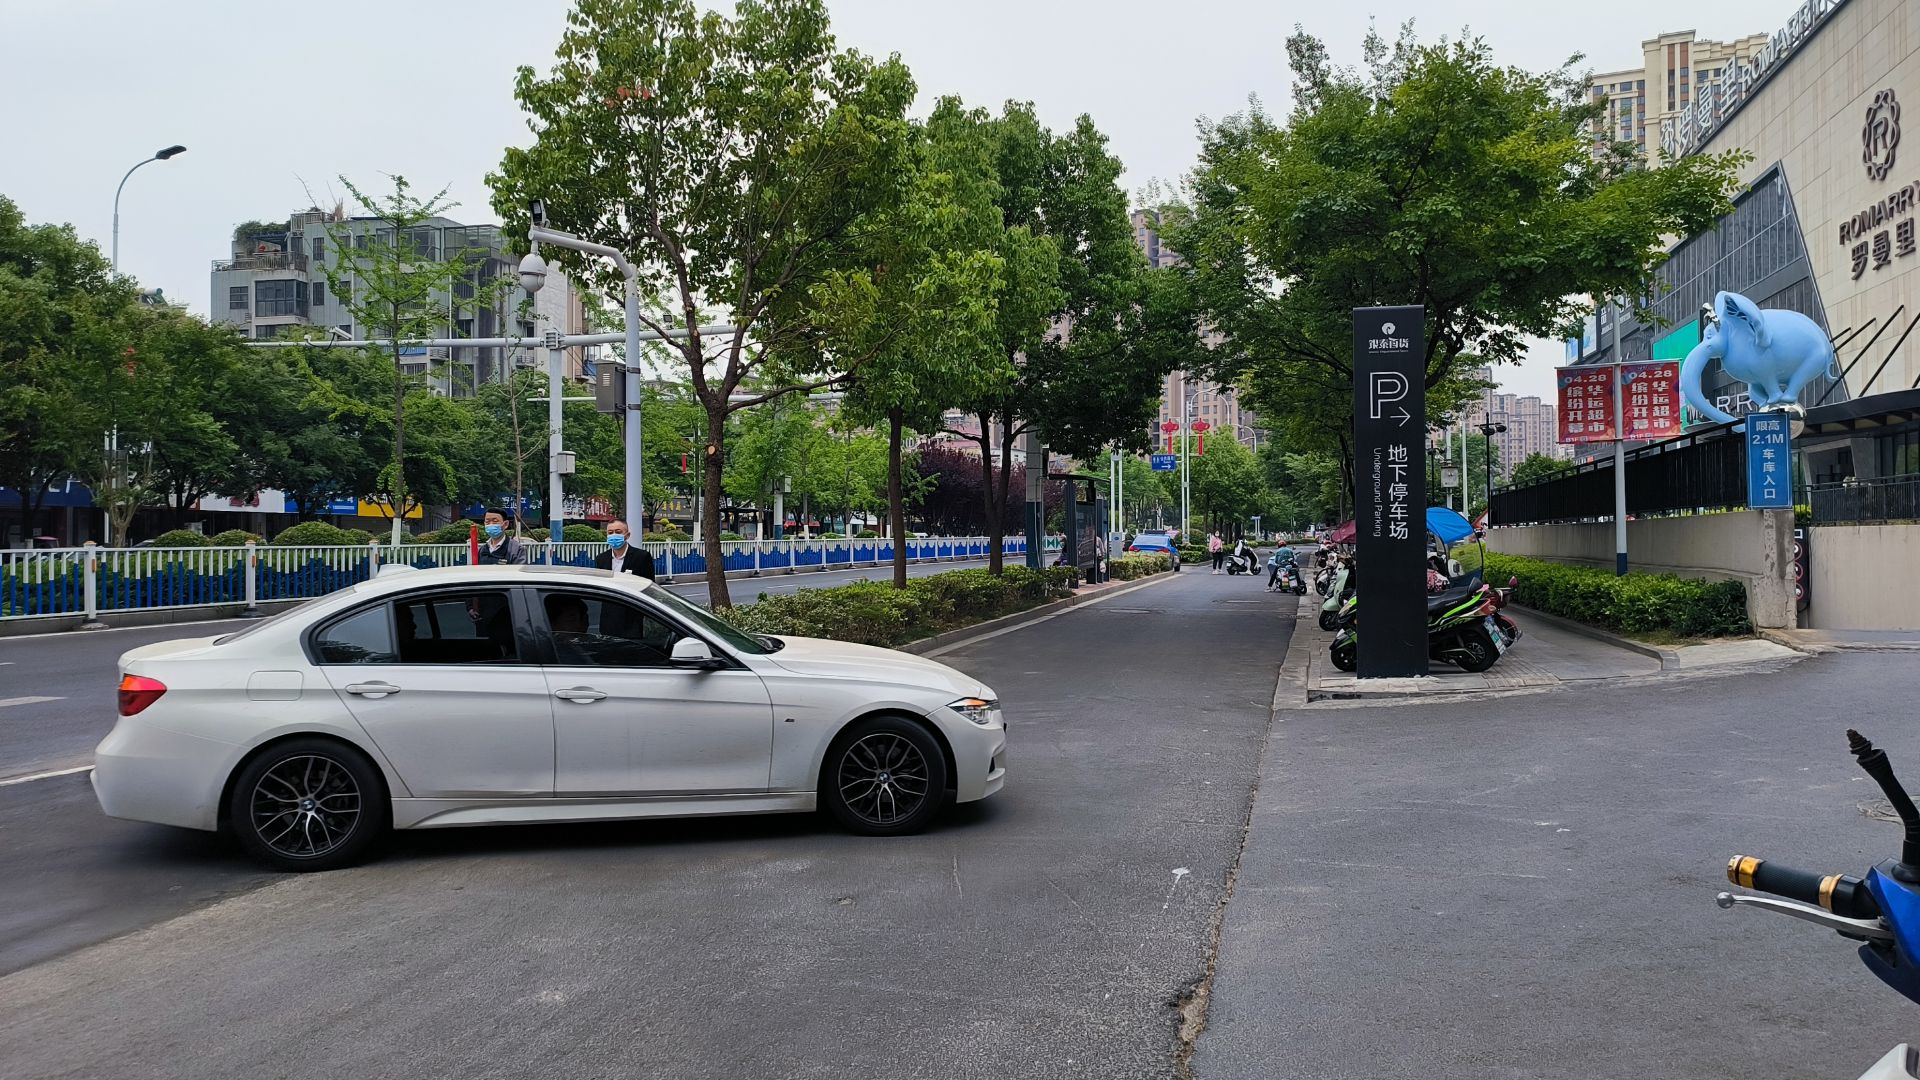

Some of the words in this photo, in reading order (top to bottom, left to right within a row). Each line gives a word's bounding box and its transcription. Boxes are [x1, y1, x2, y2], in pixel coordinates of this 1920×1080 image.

[1851, 217, 1916, 280] 罗曼里
[1370, 371, 1409, 418] P
[1564, 374, 1607, 384] 04.28
[1628, 369, 1673, 380] 04.28
[1587, 385, 1605, 432] 华运超市
[1652, 381, 1670, 428] 华运超市
[1755, 420, 1780, 431] 限高
[1752, 433, 1784, 445] 2.1M
[1373, 447, 1382, 503] Underground
[1388, 444, 1409, 540] 地下停车场
[1762, 448, 1776, 499] 车库入口
[1373, 505, 1383, 537] Parking
